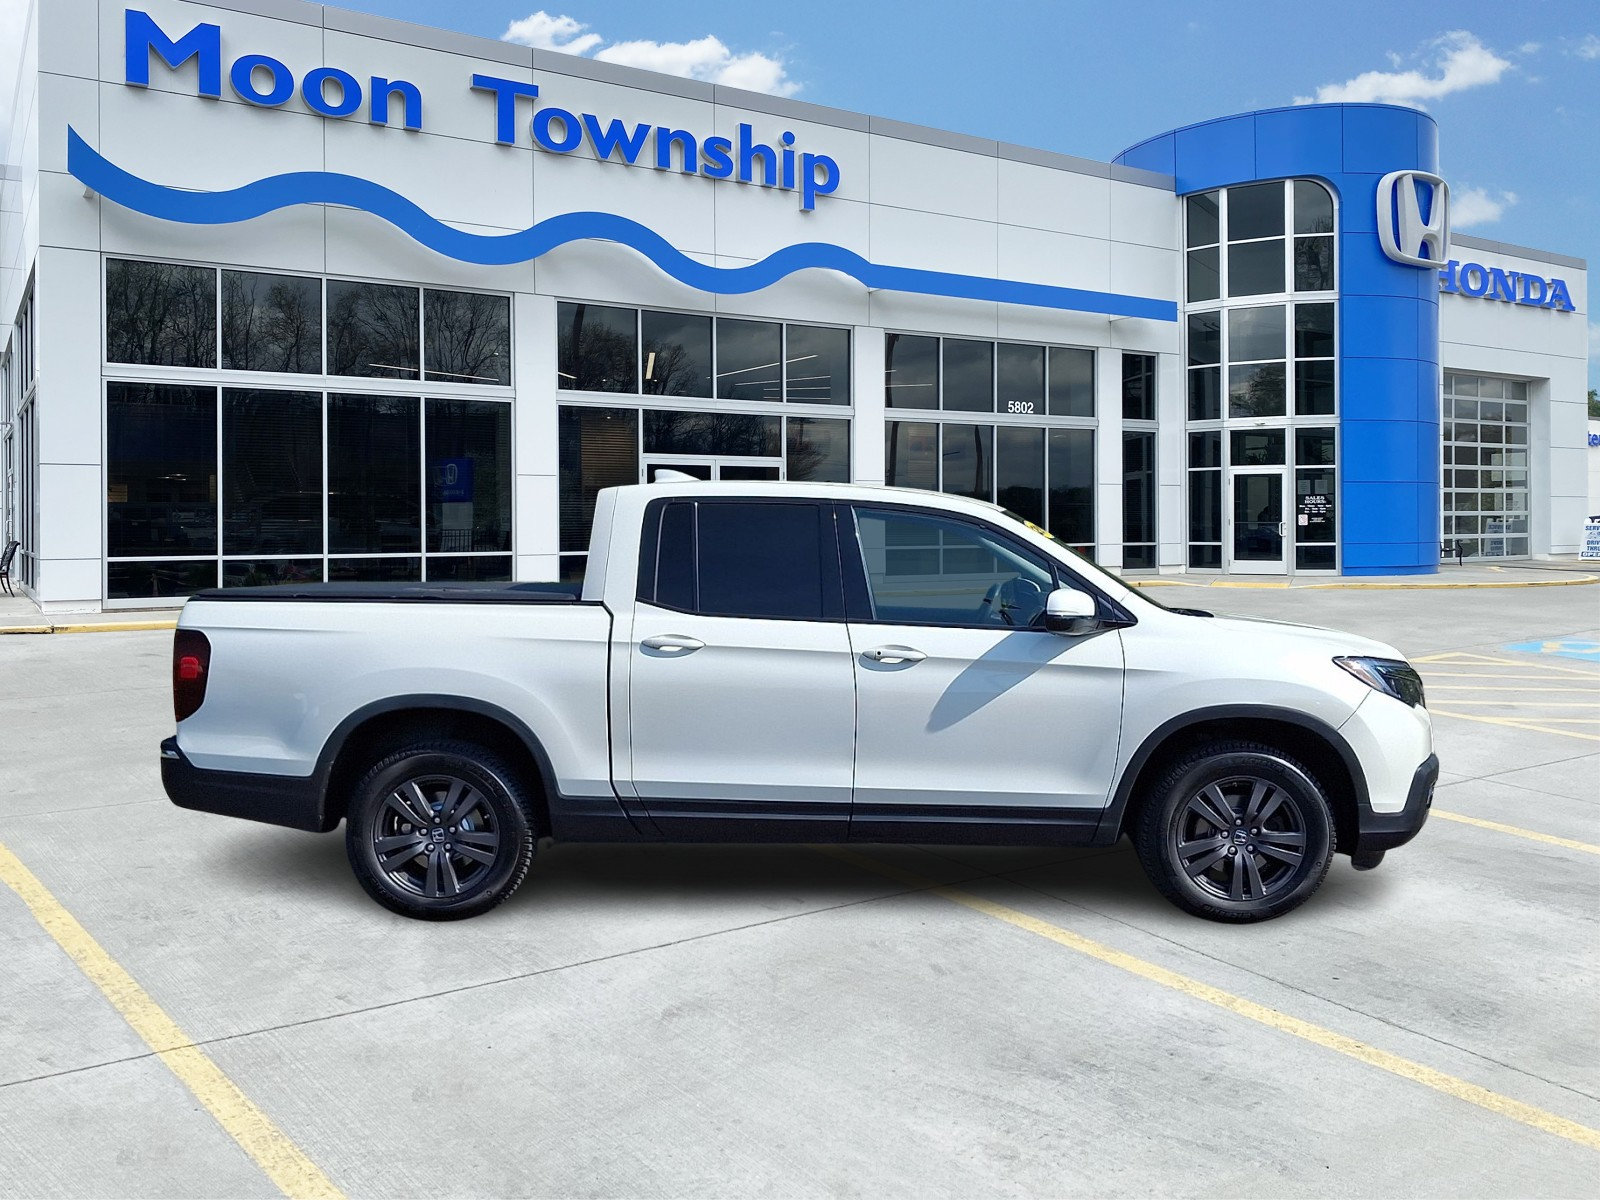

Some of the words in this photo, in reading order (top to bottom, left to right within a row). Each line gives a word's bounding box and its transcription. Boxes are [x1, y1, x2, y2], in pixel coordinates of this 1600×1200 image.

[125, 9, 422, 131] Moon
[470, 73, 841, 212] Township
[1007, 400, 1035, 414] 5802
